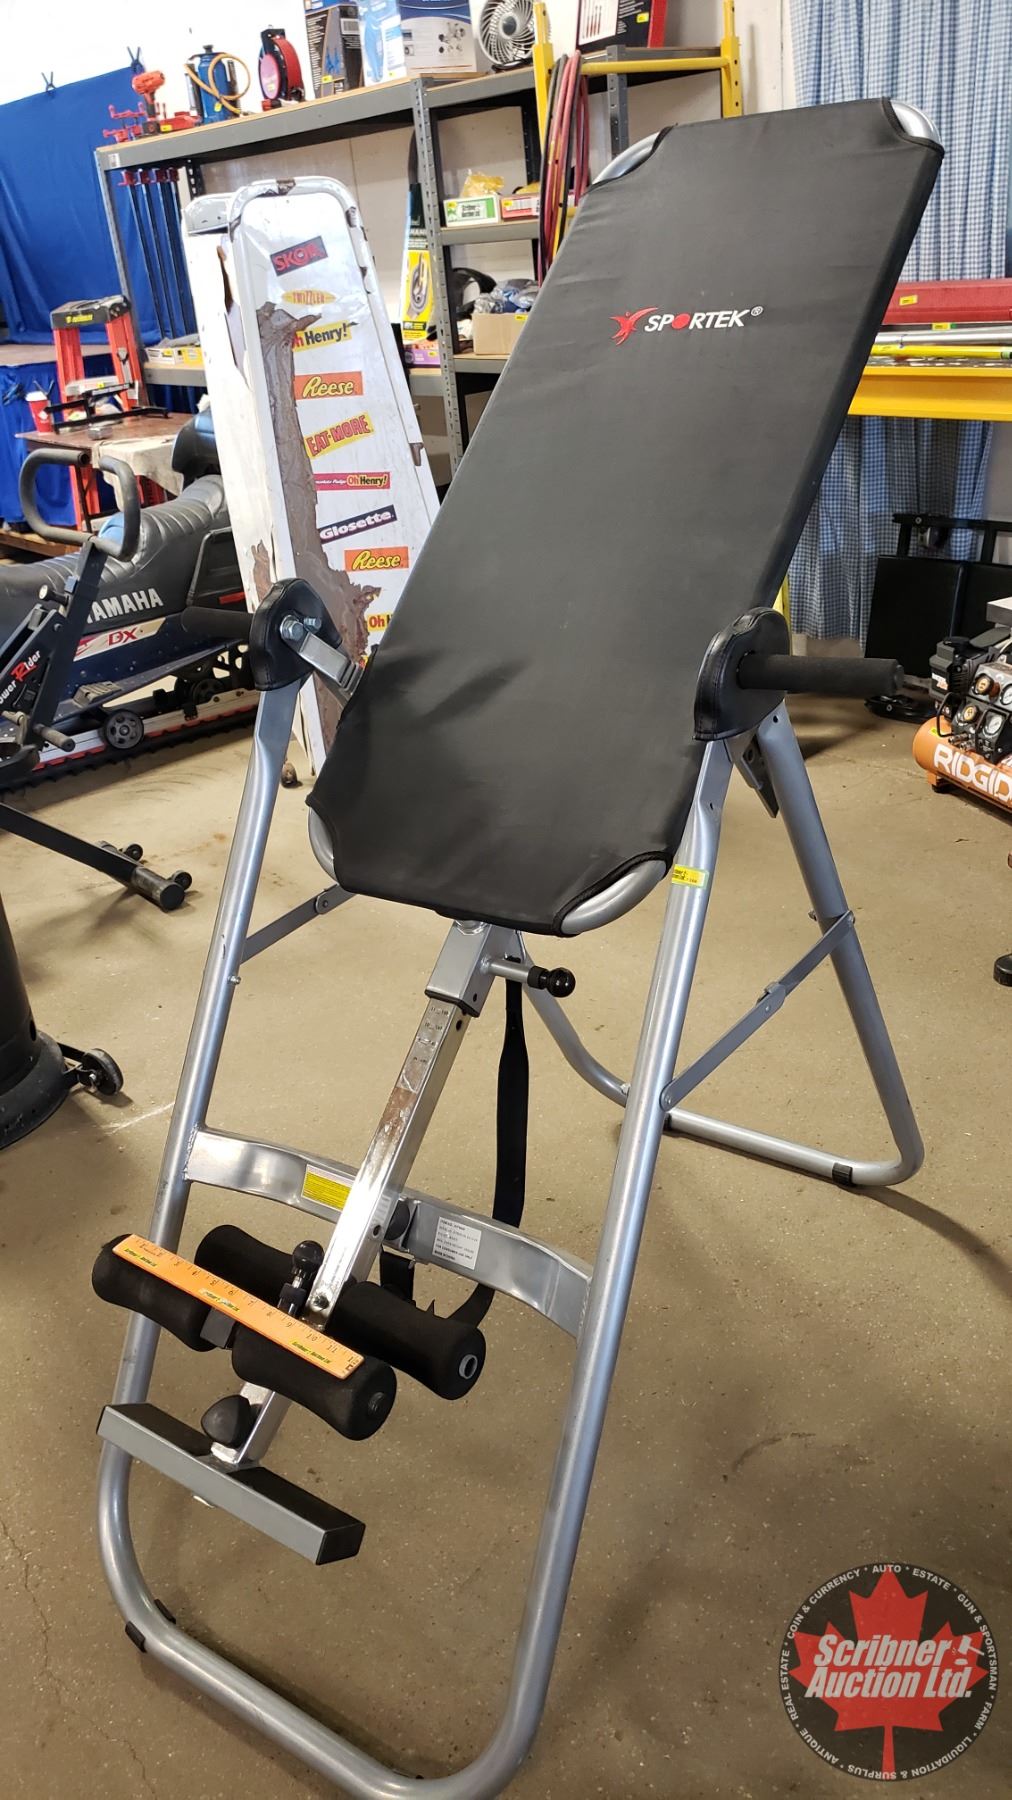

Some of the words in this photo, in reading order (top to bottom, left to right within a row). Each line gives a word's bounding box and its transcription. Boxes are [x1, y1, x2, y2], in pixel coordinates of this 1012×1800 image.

[644, 309, 750, 332] SPORTEK
[304, 322, 347, 346] Henry!
[303, 376, 354, 398] Reese
[347, 476, 359, 485] Oh
[359, 475, 388, 487] Henry!
[320, 509, 393, 540] Glosette
[352, 550, 401, 570] Reese
[368, 615, 386, 628] Oh
[108, 627, 138, 646] DX
[933, 744, 1012, 802] RIDGID
